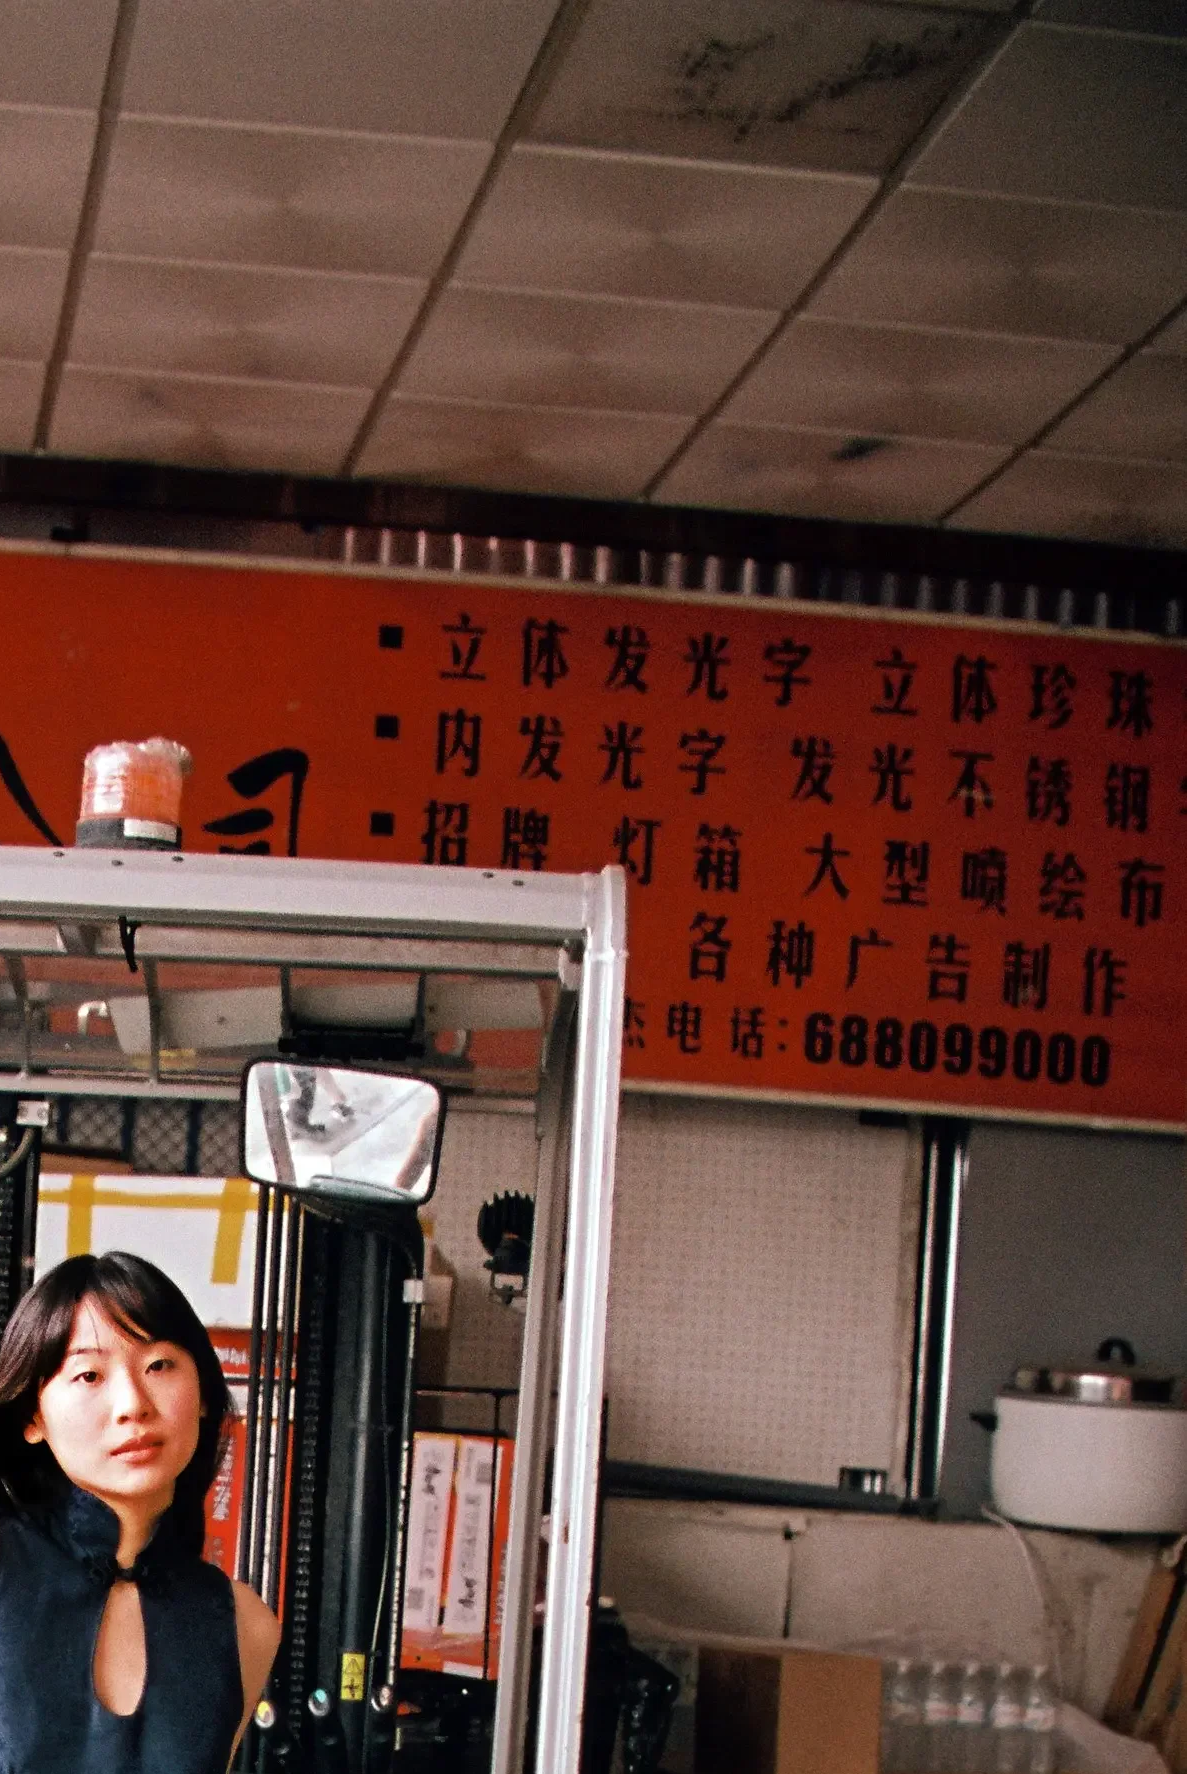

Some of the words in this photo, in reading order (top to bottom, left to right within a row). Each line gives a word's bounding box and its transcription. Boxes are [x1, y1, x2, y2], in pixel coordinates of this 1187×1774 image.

[439, 613, 812, 707] 立体发光字
[870, 647, 1187, 737] 立体珍珠
[435, 709, 726, 796] 内发光字
[790, 735, 1187, 833] 发光不锈钢
[613, 815, 742, 892] 灯箱
[803, 832, 1166, 927] 大型喷绘布
[688, 911, 1128, 1017] 各种广告制作
